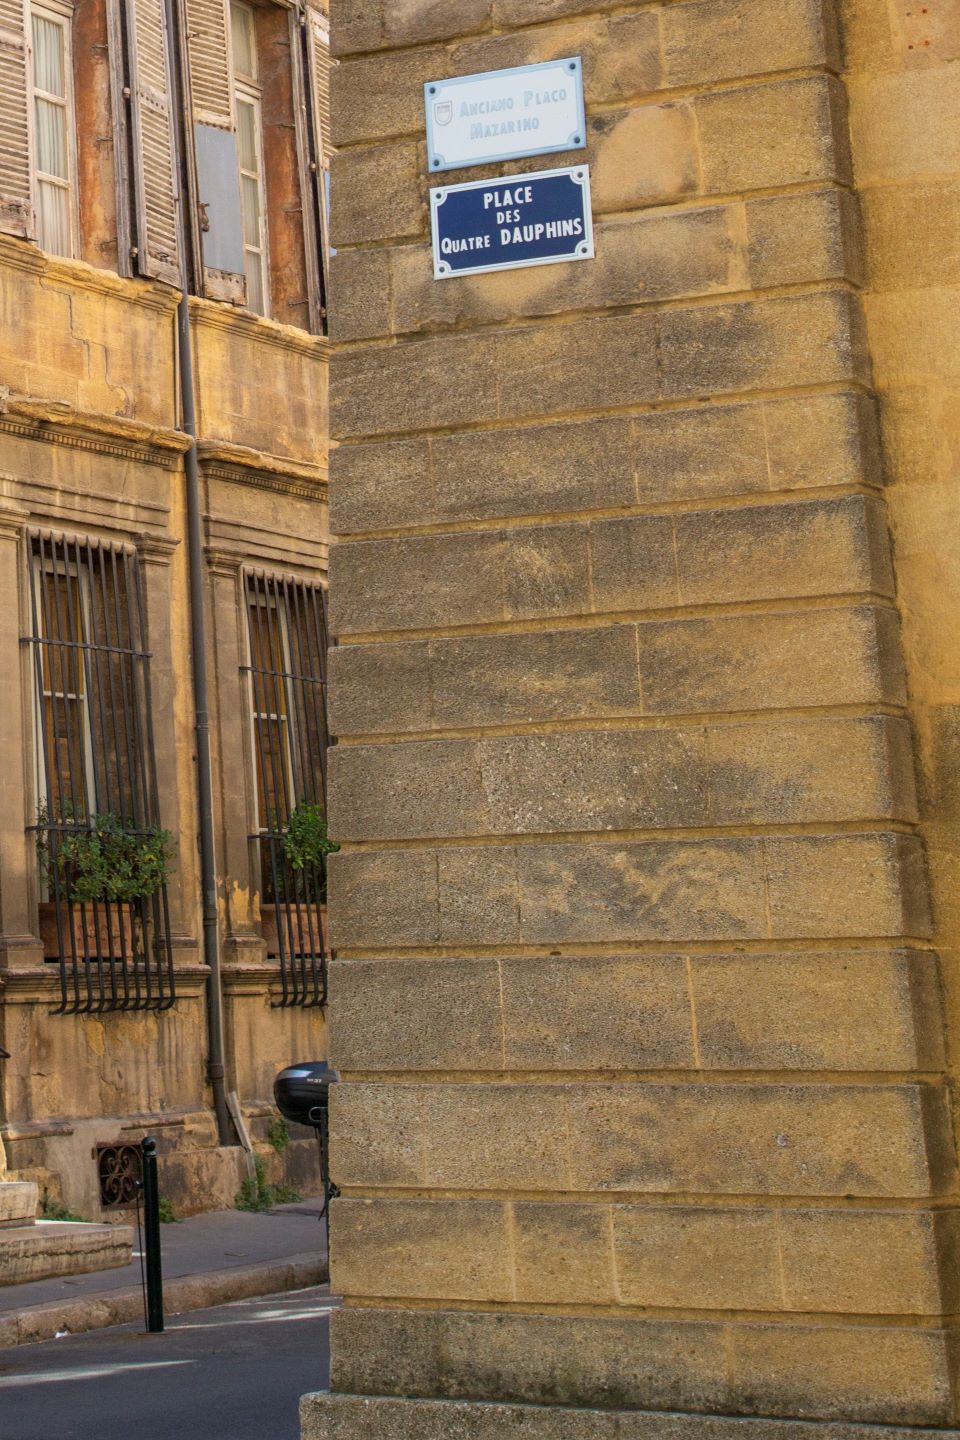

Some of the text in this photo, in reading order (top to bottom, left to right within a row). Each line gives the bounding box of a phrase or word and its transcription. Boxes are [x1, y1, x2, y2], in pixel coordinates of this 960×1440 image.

[459, 88, 567, 118] ANCIANO PLACO
[470, 117, 540, 140] MAZARINO
[483, 186, 533, 210] PLACE
[496, 210, 521, 225] DES
[441, 218, 583, 254] QUATRE DAUPHINS
